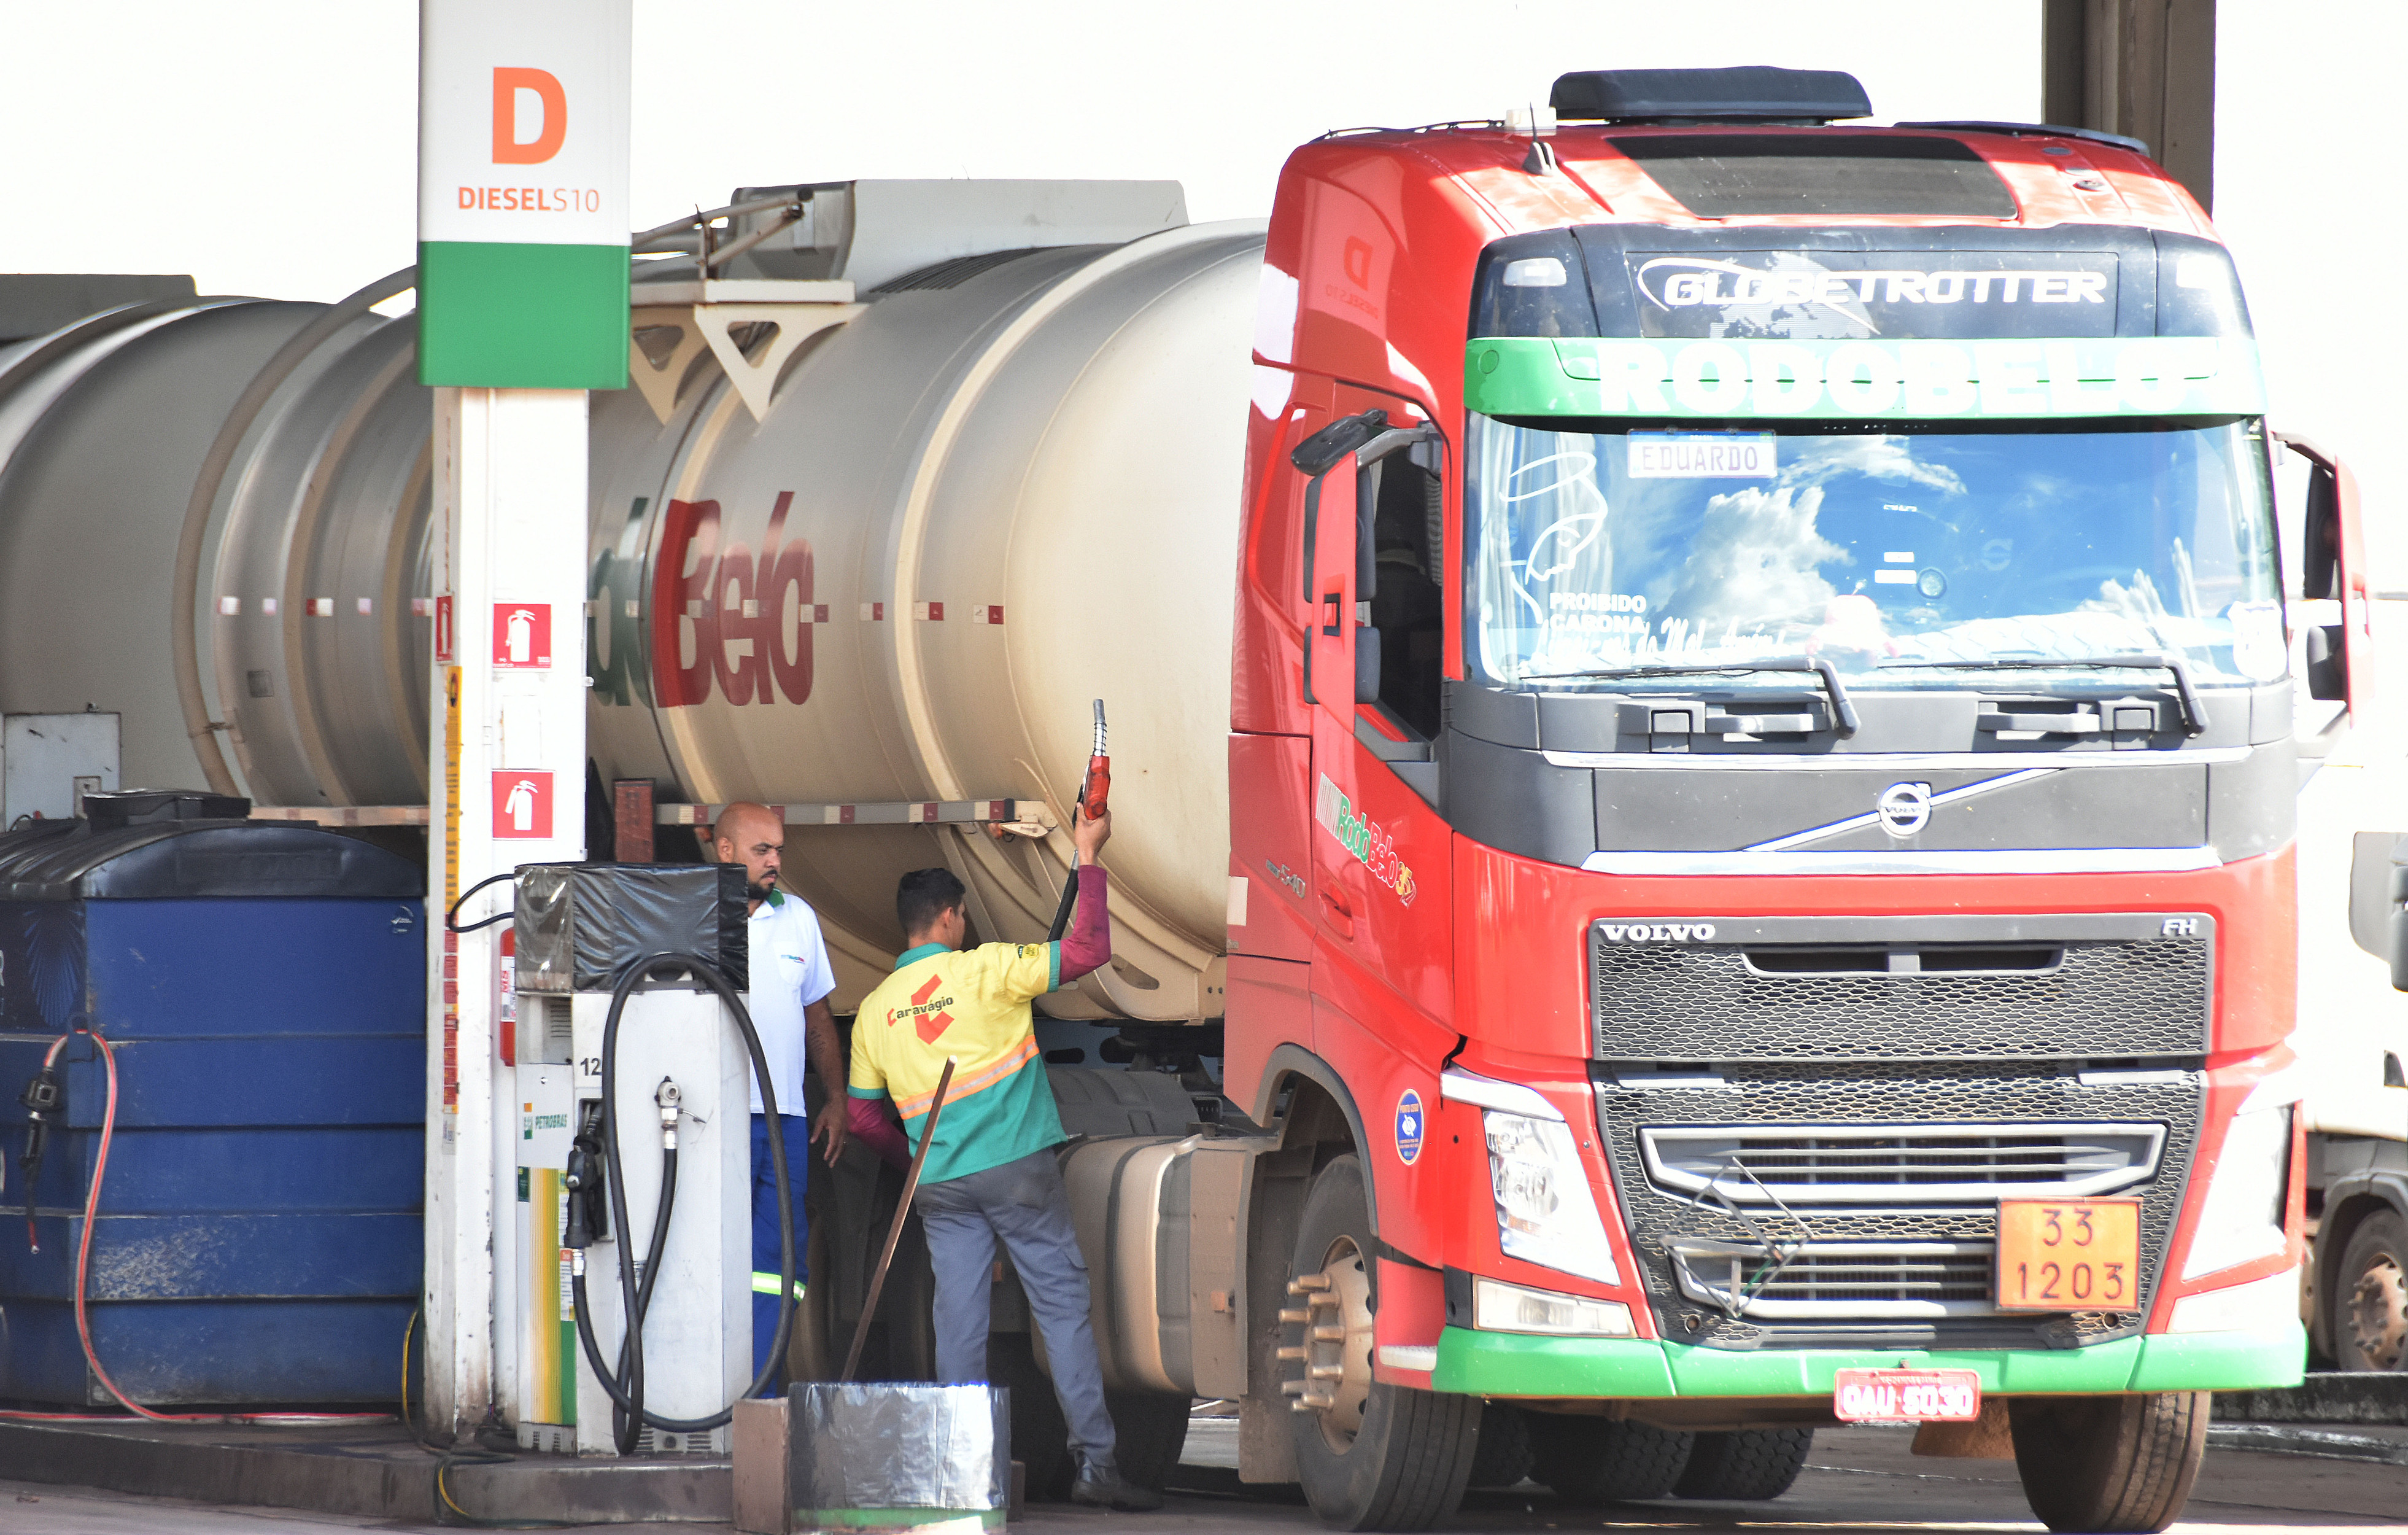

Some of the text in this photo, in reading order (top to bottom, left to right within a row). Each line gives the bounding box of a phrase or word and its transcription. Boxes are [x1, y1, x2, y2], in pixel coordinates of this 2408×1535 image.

[492, 66, 568, 165] D
[1663, 270, 2107, 305] GLOBETROTTER
[1596, 343, 2193, 414] RODOBELO
[1641, 445, 1759, 472] EDUARDO
[1549, 592, 1647, 613] PROIBIDO
[1280, 863, 1306, 899] 540
[1598, 923, 1716, 942] VOLVO
[2162, 918, 2197, 935] FH
[2042, 1208, 2094, 1247] 33
[2017, 1261, 2124, 1300] 1203
